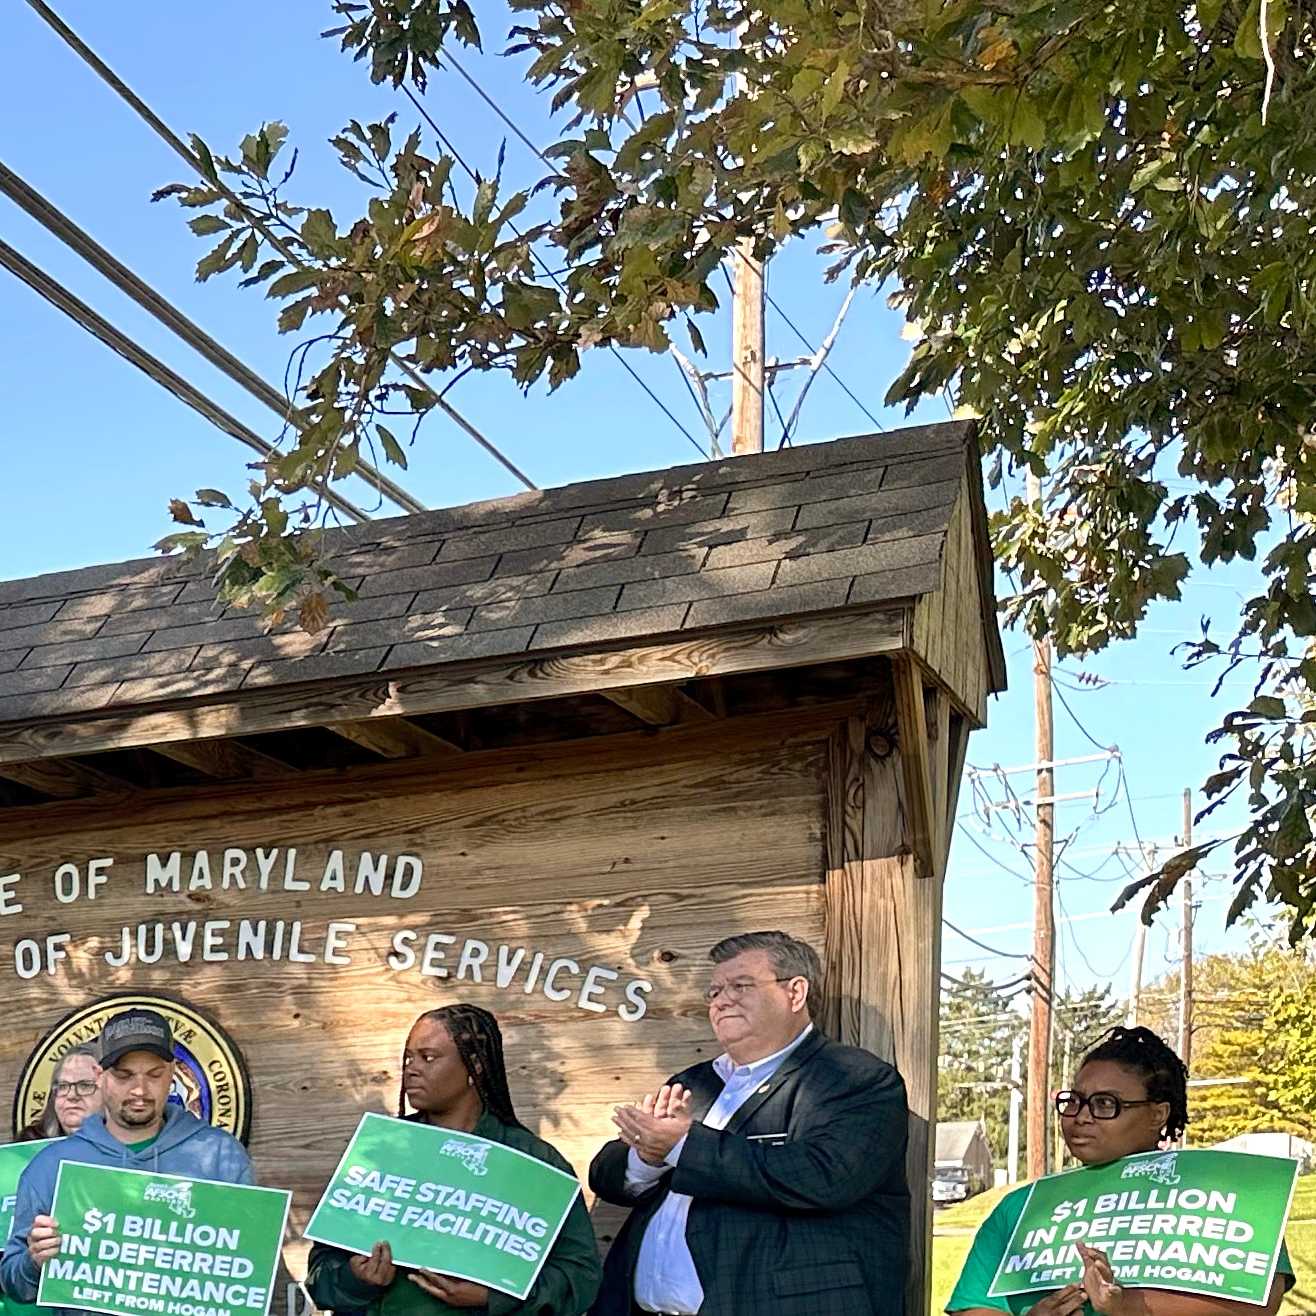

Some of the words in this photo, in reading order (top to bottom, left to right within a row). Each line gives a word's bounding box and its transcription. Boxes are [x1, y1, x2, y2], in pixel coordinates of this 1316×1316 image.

[55, 857, 114, 904] OF
[146, 848, 423, 898] MARYLAND
[15, 933, 71, 979] OF
[105, 920, 356, 967] JUVENILE
[387, 930, 652, 1022] SERVICES
[208, 1060, 232, 1128] CORONA
[328, 1188, 401, 1223] SAFE
[400, 1205, 541, 1262] FACILITIES
[344, 1165, 417, 1199] SAFE
[415, 1182, 548, 1238] STAFFING
[1051, 1199, 1088, 1223] $1
[1093, 1188, 1236, 1214] BILLION
[83, 1208, 116, 1234] $1
[122, 1215, 240, 1250] BILLION
[1023, 1226, 1058, 1248] IN
[1063, 1213, 1254, 1243] DEFERRED
[61, 1234, 91, 1257] IN
[99, 1239, 253, 1279] DEFERRED
[1030, 1268, 1076, 1284] LEFT
[1143, 1265, 1225, 1287] HOGAN
[48, 1258, 266, 1308] MAINTENANCE
[73, 1287, 112, 1303] LEFT
[115, 1294, 163, 1312] FROM
